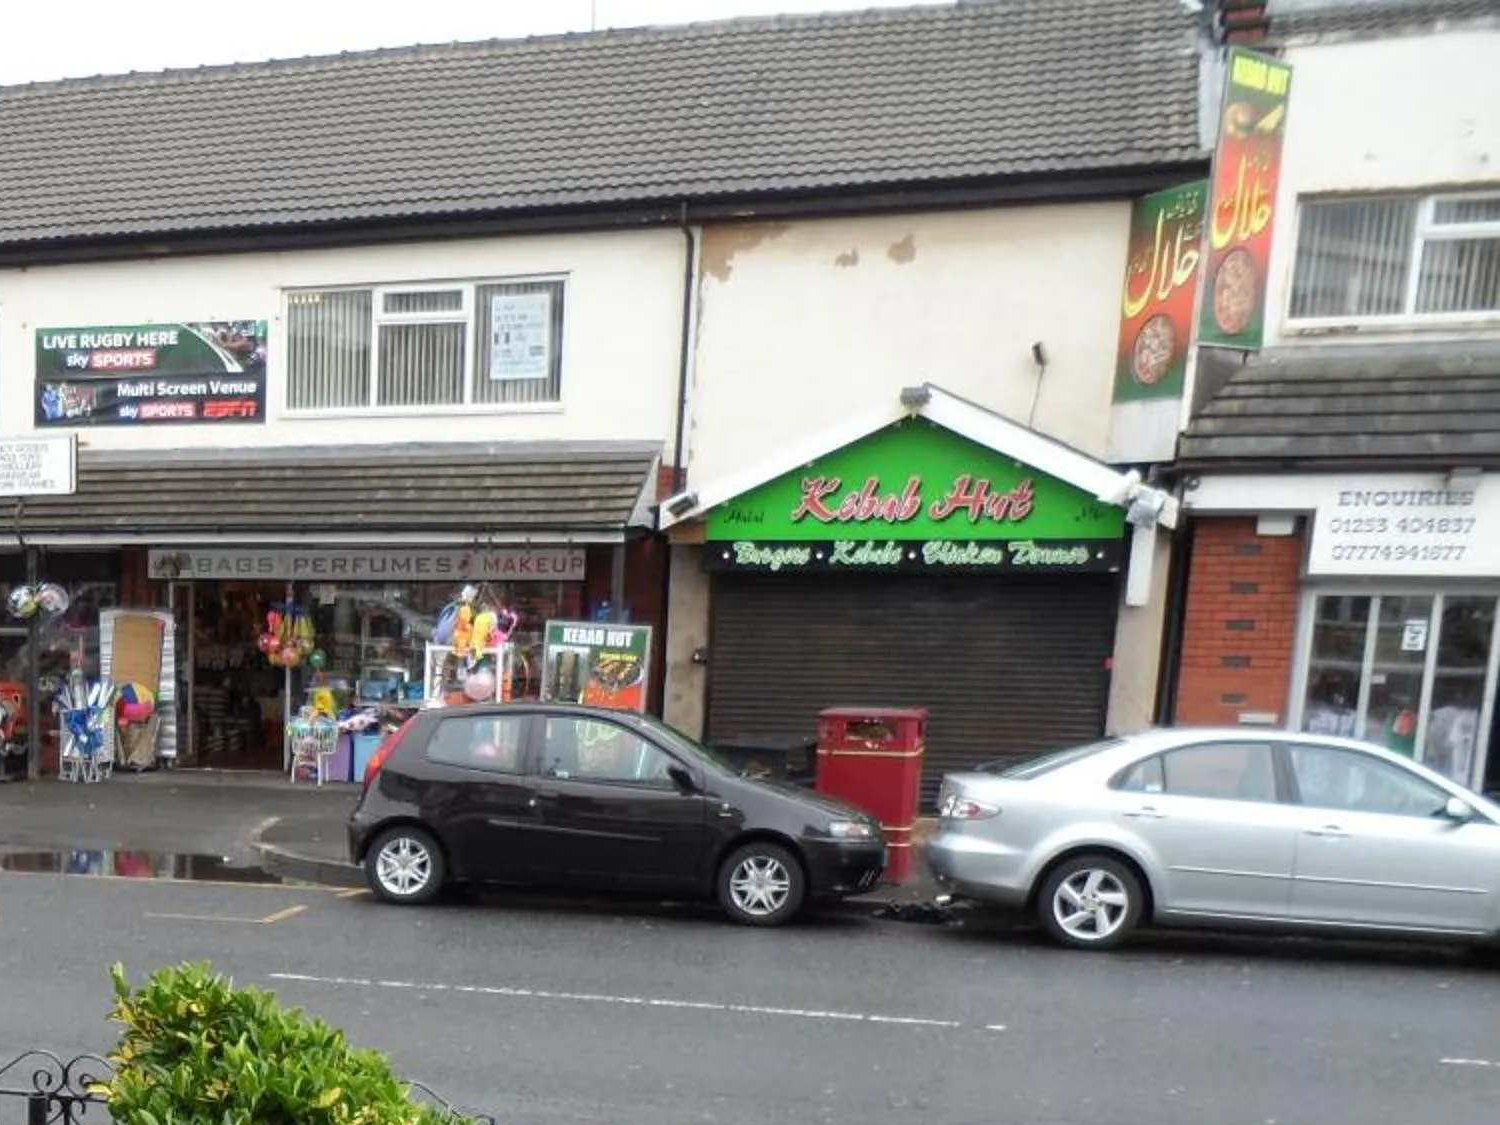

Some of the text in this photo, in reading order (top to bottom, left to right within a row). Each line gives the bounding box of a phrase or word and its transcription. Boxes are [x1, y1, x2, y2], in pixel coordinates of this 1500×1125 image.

[43, 331, 179, 349] LIVE RUGBY HERE
[66, 352, 153, 368] sky SPORTS
[117, 380, 257, 396] Multi Screen Venue
[118, 401, 257, 419] sky SPORTS ESPN
[791, 474, 1034, 523] Kebab Hut
[1338, 490, 1475, 507] ENQUIRIES
[1330, 516, 1477, 534] 01253 404837
[829, 539, 903, 565] Kebabs
[922, 540, 1003, 565] Chicken
[198, 556, 583, 574] BAGS PERFUMES MAKEUP
[563, 627, 633, 648] KEBAB HUT
